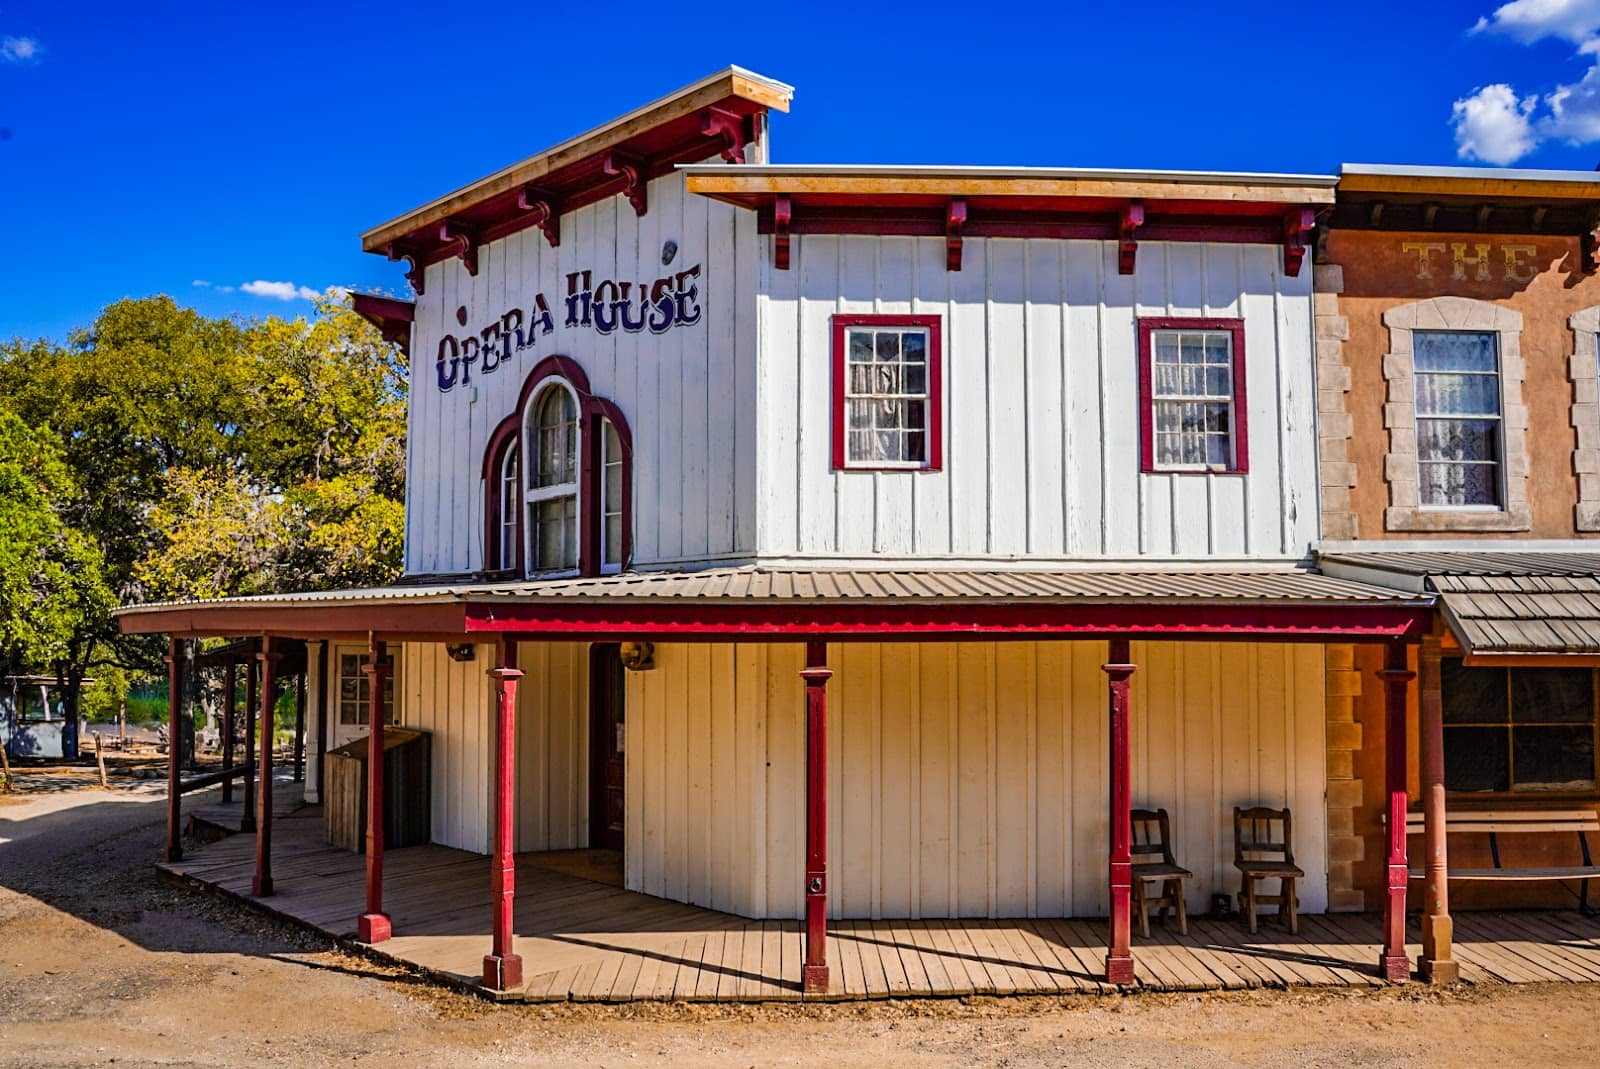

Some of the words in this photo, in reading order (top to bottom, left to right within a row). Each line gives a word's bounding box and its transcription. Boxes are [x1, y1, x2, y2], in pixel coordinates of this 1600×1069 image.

[1402, 242, 1538, 283] THE
[436, 293, 554, 392] OPERA
[564, 264, 702, 335] HOUSE
